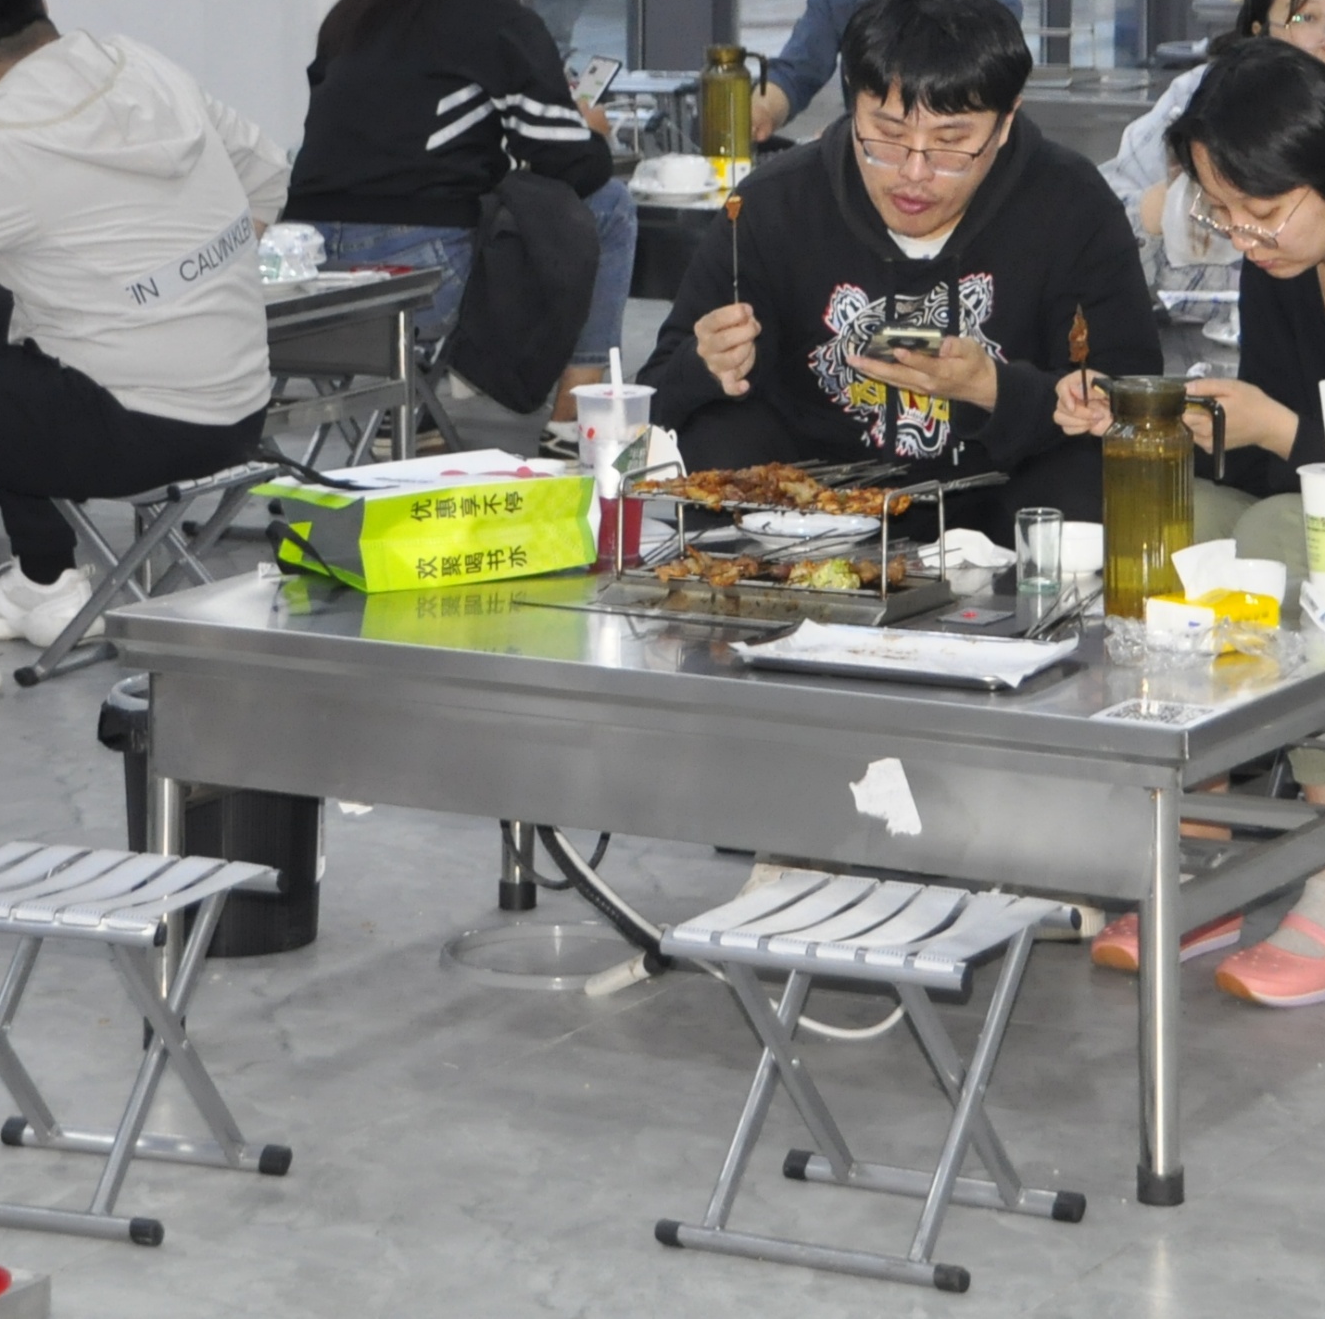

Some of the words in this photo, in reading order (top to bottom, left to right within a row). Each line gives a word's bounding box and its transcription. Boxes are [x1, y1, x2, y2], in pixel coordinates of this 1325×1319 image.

[179, 232, 234, 282] CALVIN
[410, 492, 524, 523] 优惠享不停
[416, 545, 528, 580] 欢聚喝书亦
